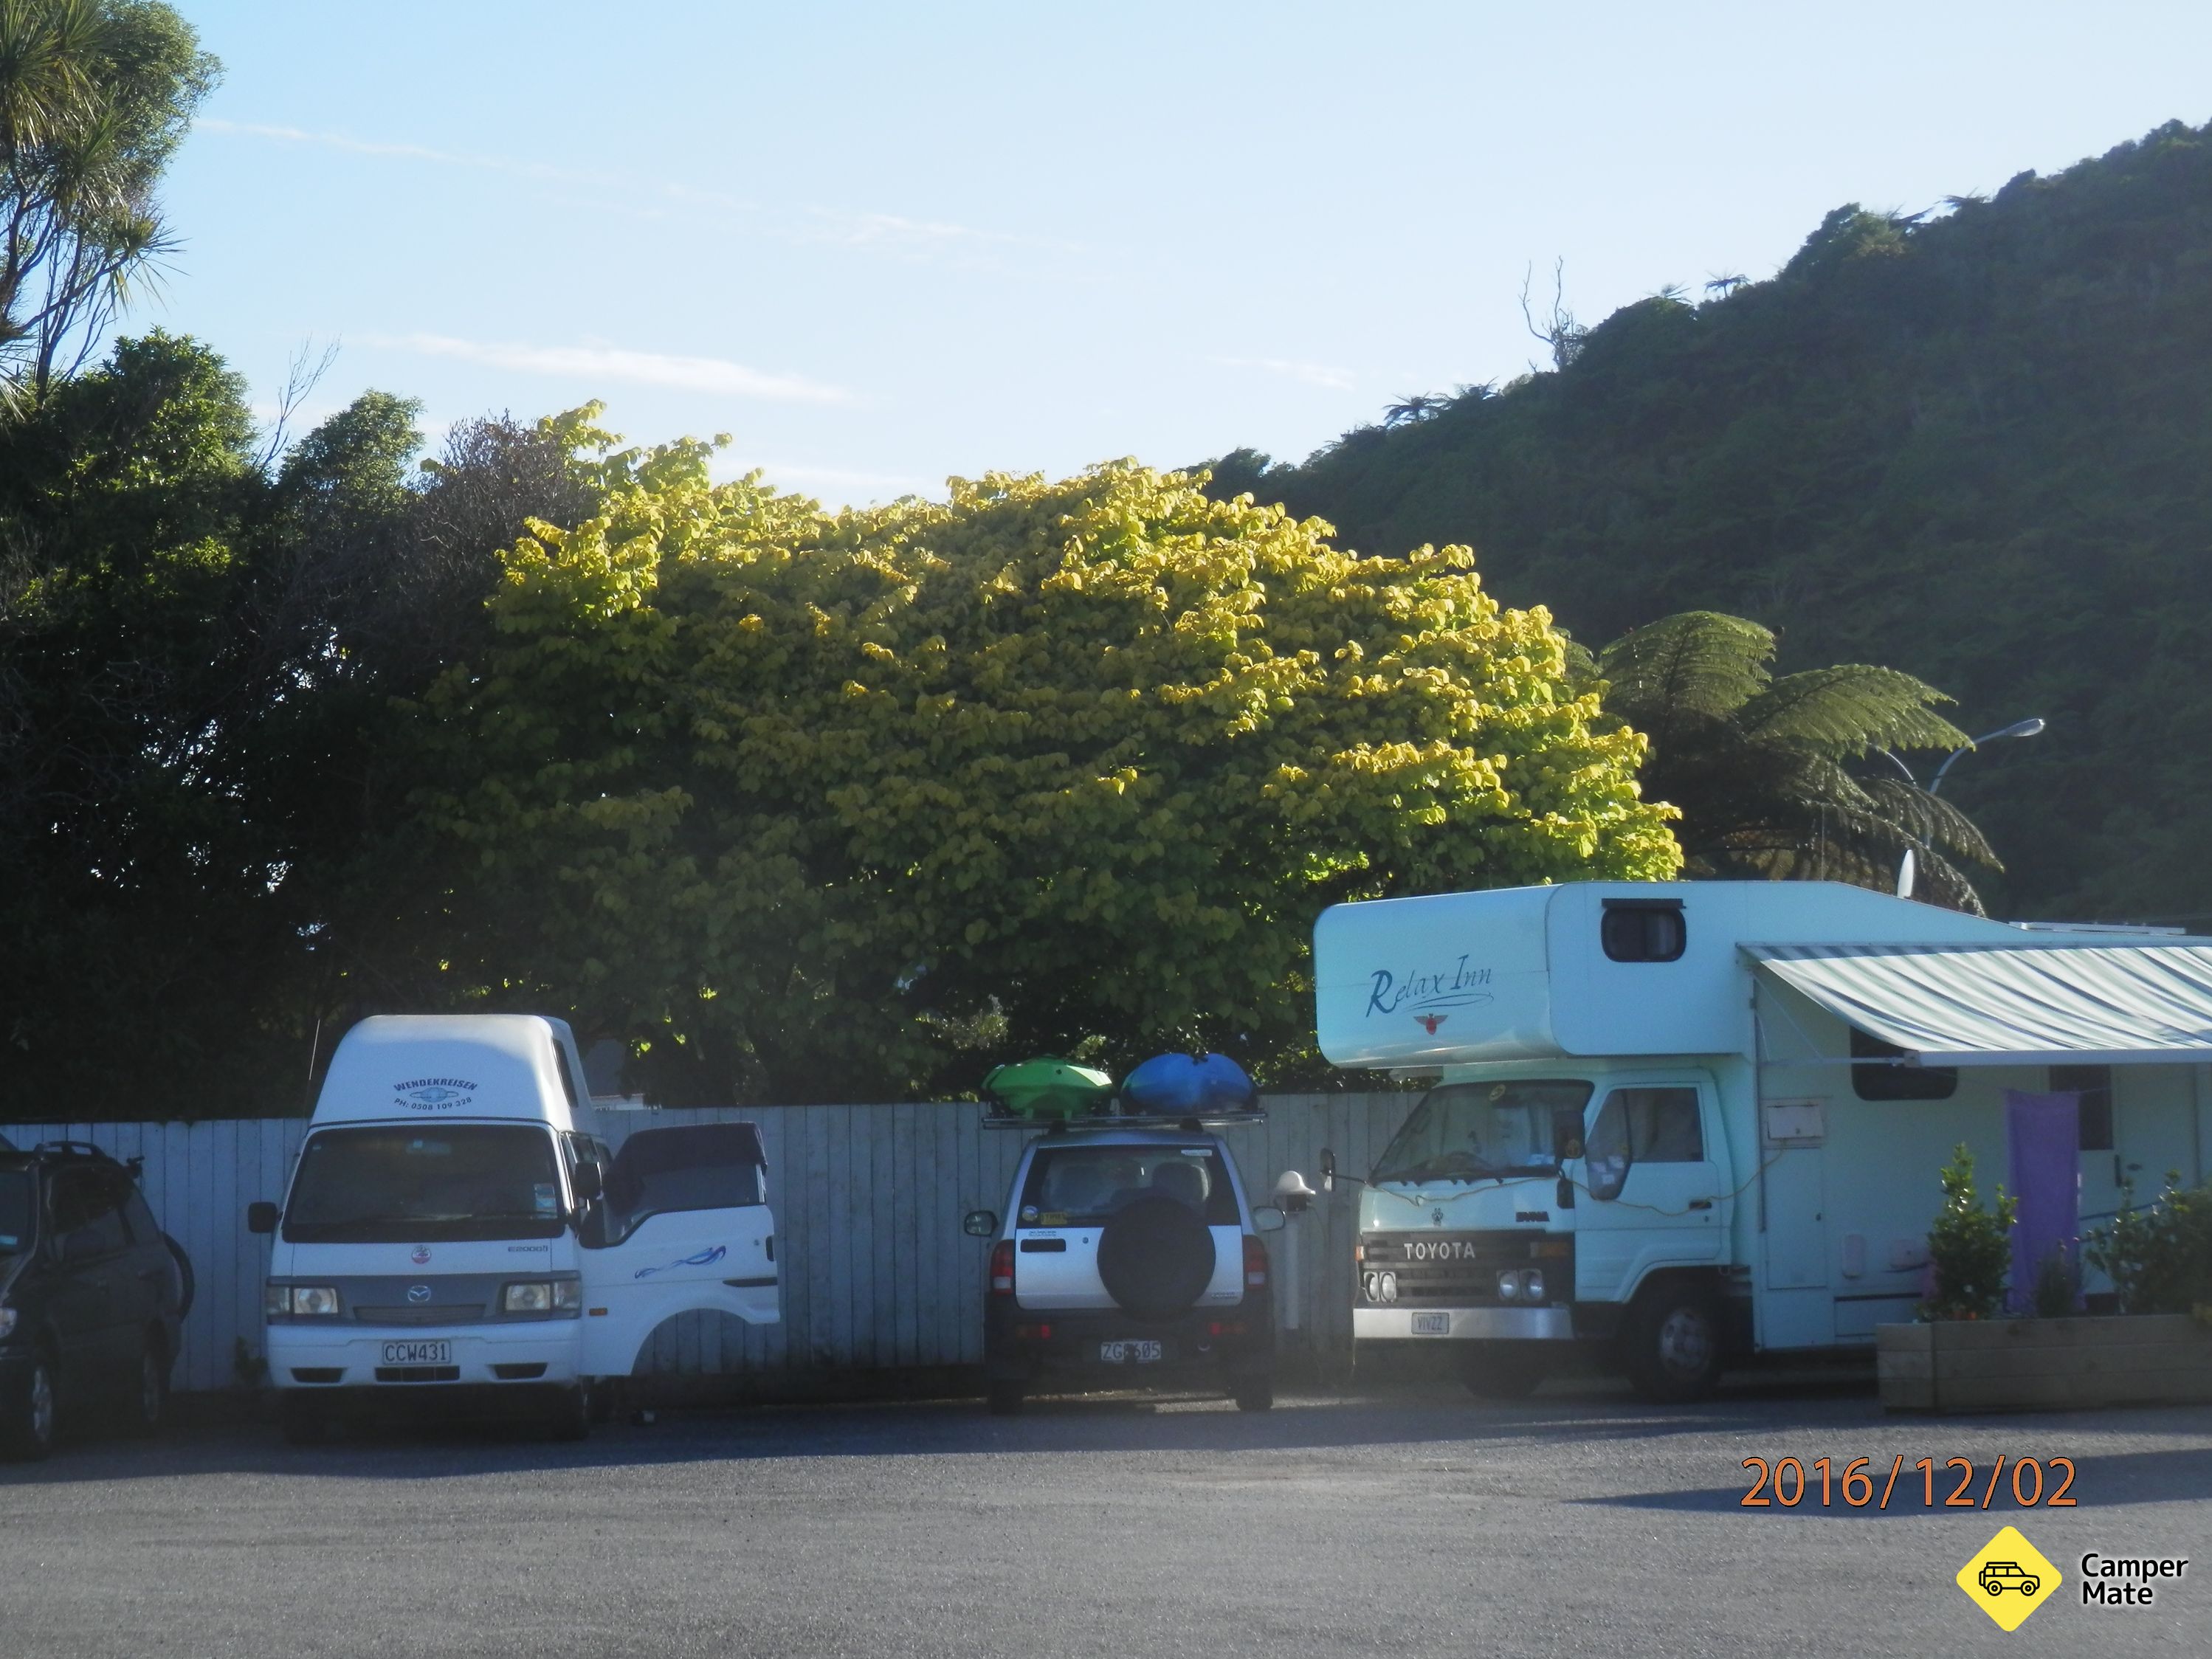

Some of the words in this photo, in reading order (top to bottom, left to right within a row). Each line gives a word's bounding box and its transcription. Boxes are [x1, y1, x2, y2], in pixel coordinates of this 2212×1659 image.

[1366, 969, 1444, 1018] Relax
[1450, 953, 1492, 990] Inn
[393, 1078, 478, 1091] WENDEKREISEN
[394, 1097, 409, 1108] PH:
[411, 1103, 433, 1111] 0508
[455, 1097, 472, 1107] 328
[1404, 1242, 1475, 1260] TOYOTA
[385, 1343, 447, 1362] CCW431
